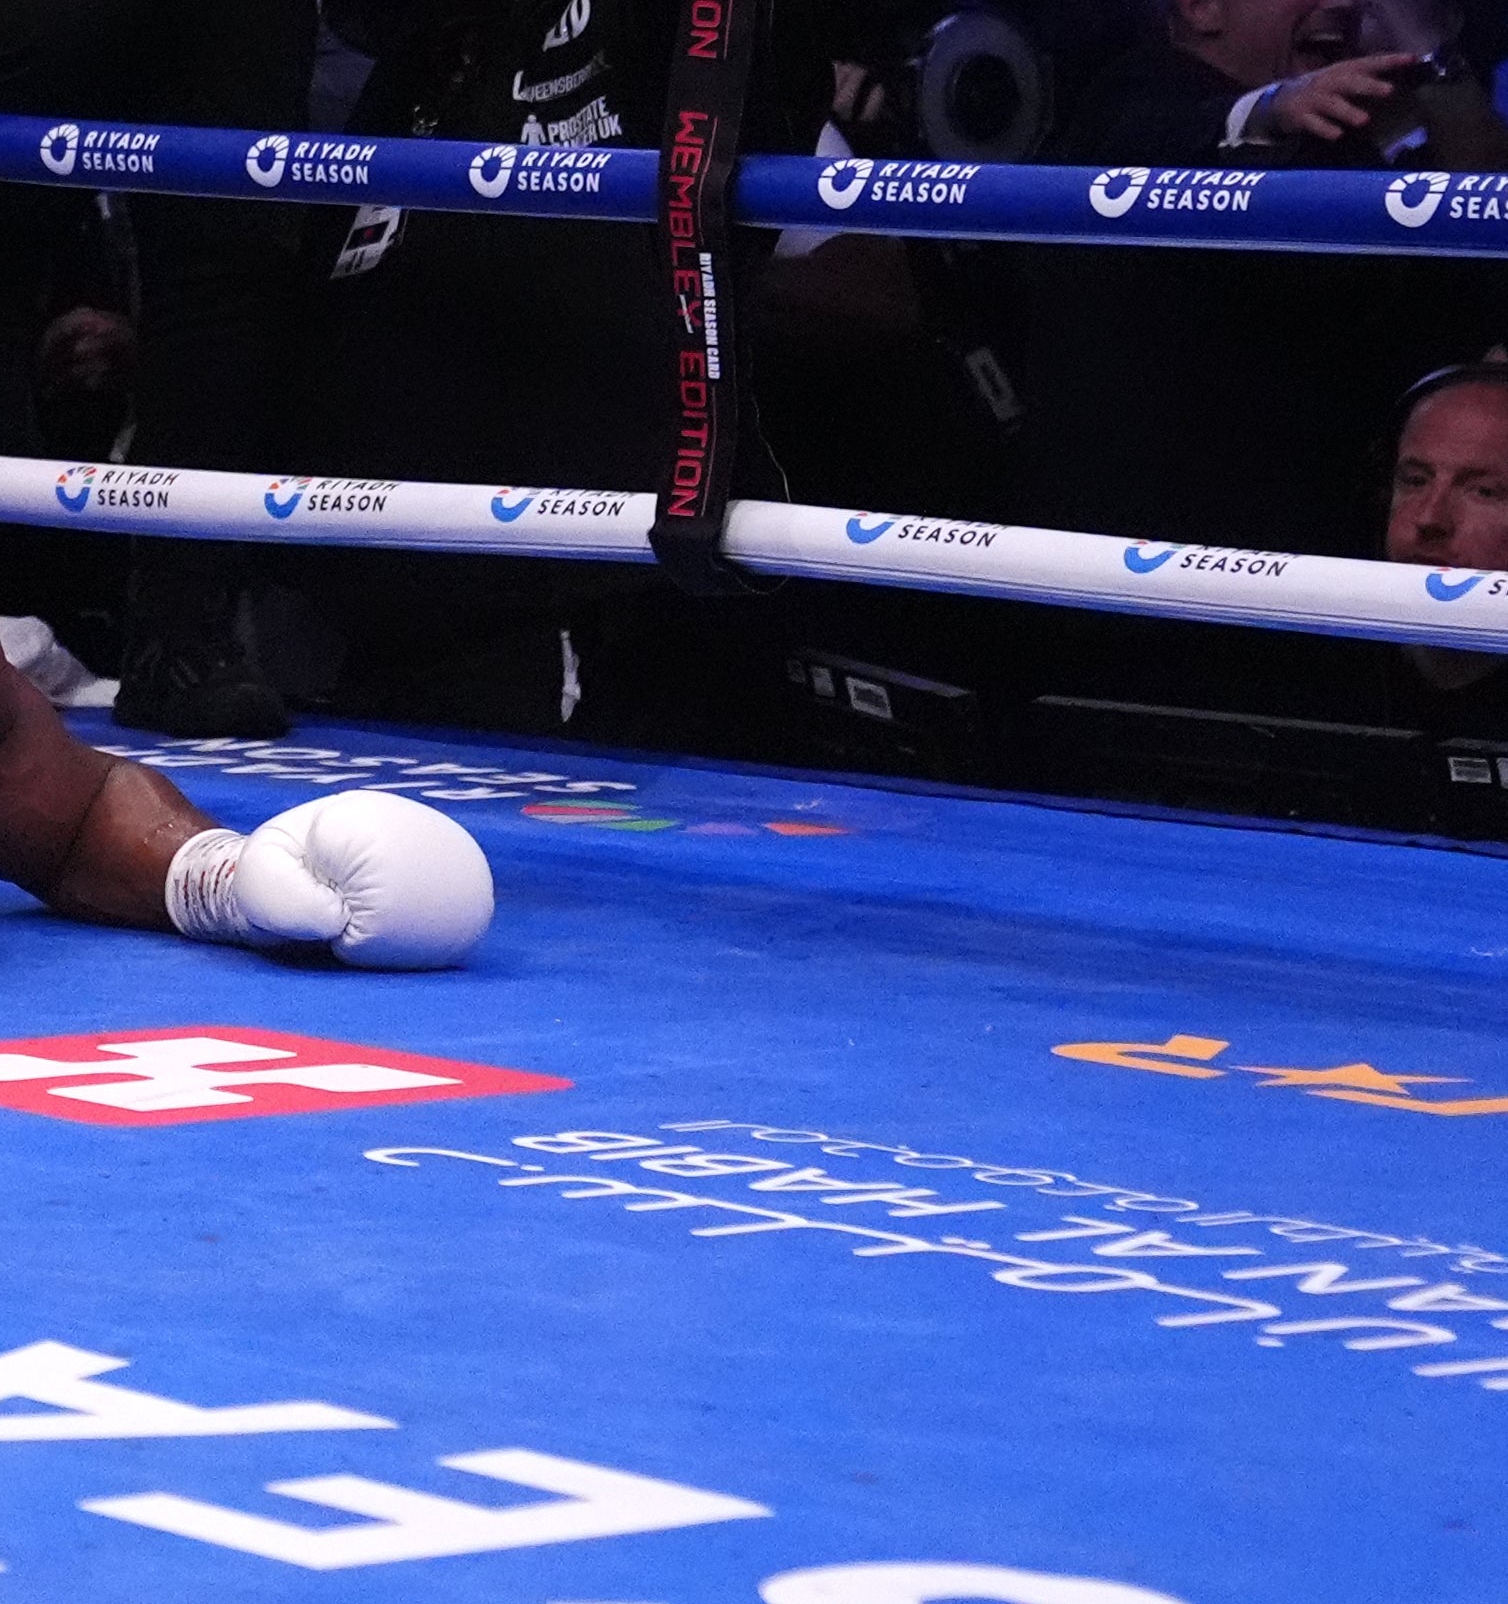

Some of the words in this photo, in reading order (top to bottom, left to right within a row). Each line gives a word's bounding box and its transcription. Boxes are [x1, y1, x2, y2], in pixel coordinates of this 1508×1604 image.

[83, 130, 161, 151] RIYADH
[294, 141, 377, 161] RIYADH
[82, 151, 154, 173] SEASON
[521, 150, 612, 169] RIYADH
[291, 162, 368, 185] SEASON
[517, 170, 600, 193] SEASON
[878, 162, 981, 180] RIYADH
[1155, 169, 1266, 186] RIYADH
[870, 180, 967, 204] SEASON
[1456, 175, 1508, 192] RIY
[1146, 188, 1251, 211] SEASON
[1449, 195, 1508, 220] SEA
[668, 110, 709, 328] WEMBLEY
[666, 350, 707, 518] EDITION
[101, 470, 179, 486] RIYADH
[97, 488, 169, 508] SEASON
[307, 494, 387, 512] SEASON
[537, 499, 625, 517] SEASON
[897, 522, 997, 548] SEASON
[1179, 551, 1288, 577] SEASON
[511, 1129, 1007, 1219] HABIB
[1016, 1216, 1266, 1258] AL
